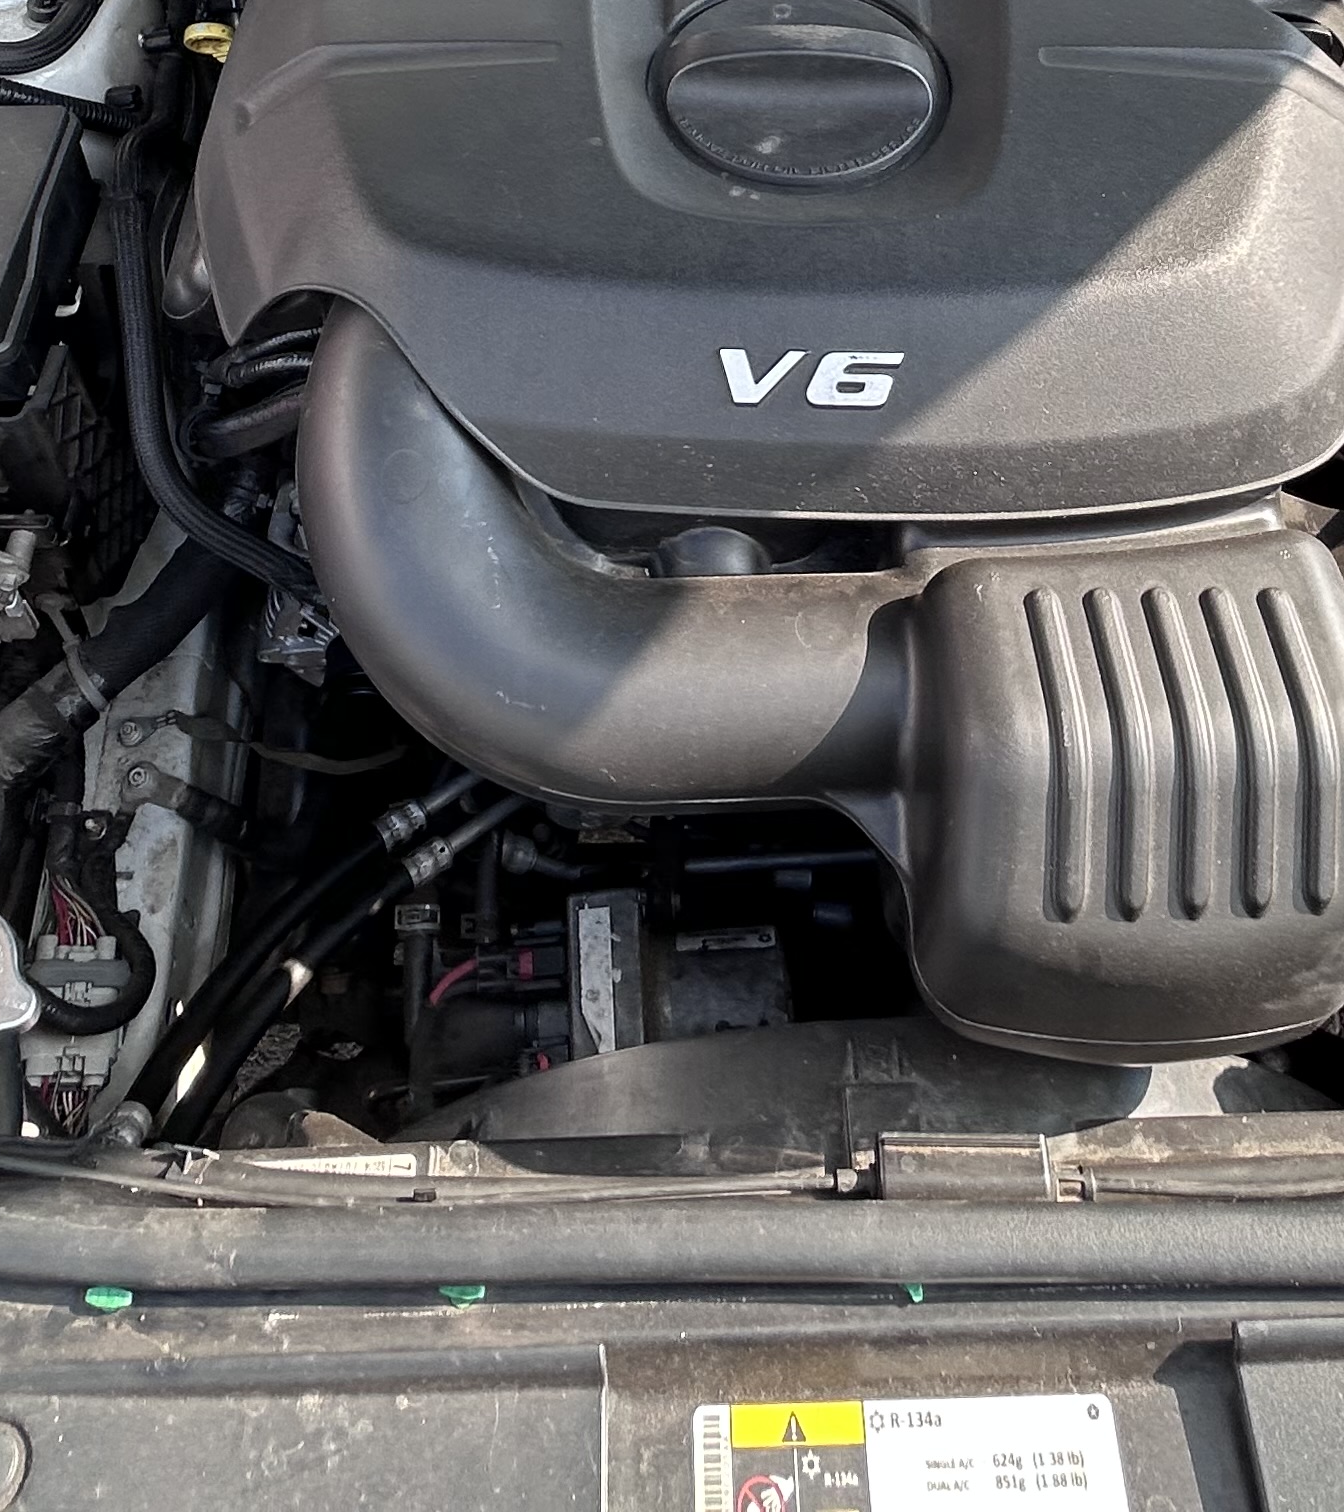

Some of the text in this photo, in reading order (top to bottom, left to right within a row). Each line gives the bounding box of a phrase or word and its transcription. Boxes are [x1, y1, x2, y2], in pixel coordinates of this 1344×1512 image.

[718, 346, 905, 408] V6
[890, 1410, 943, 1428] R-134a
[992, 1452, 1023, 1470] 624g
[1032, 1451, 1064, 1470] (138
[995, 1474, 1026, 1492] 851g
